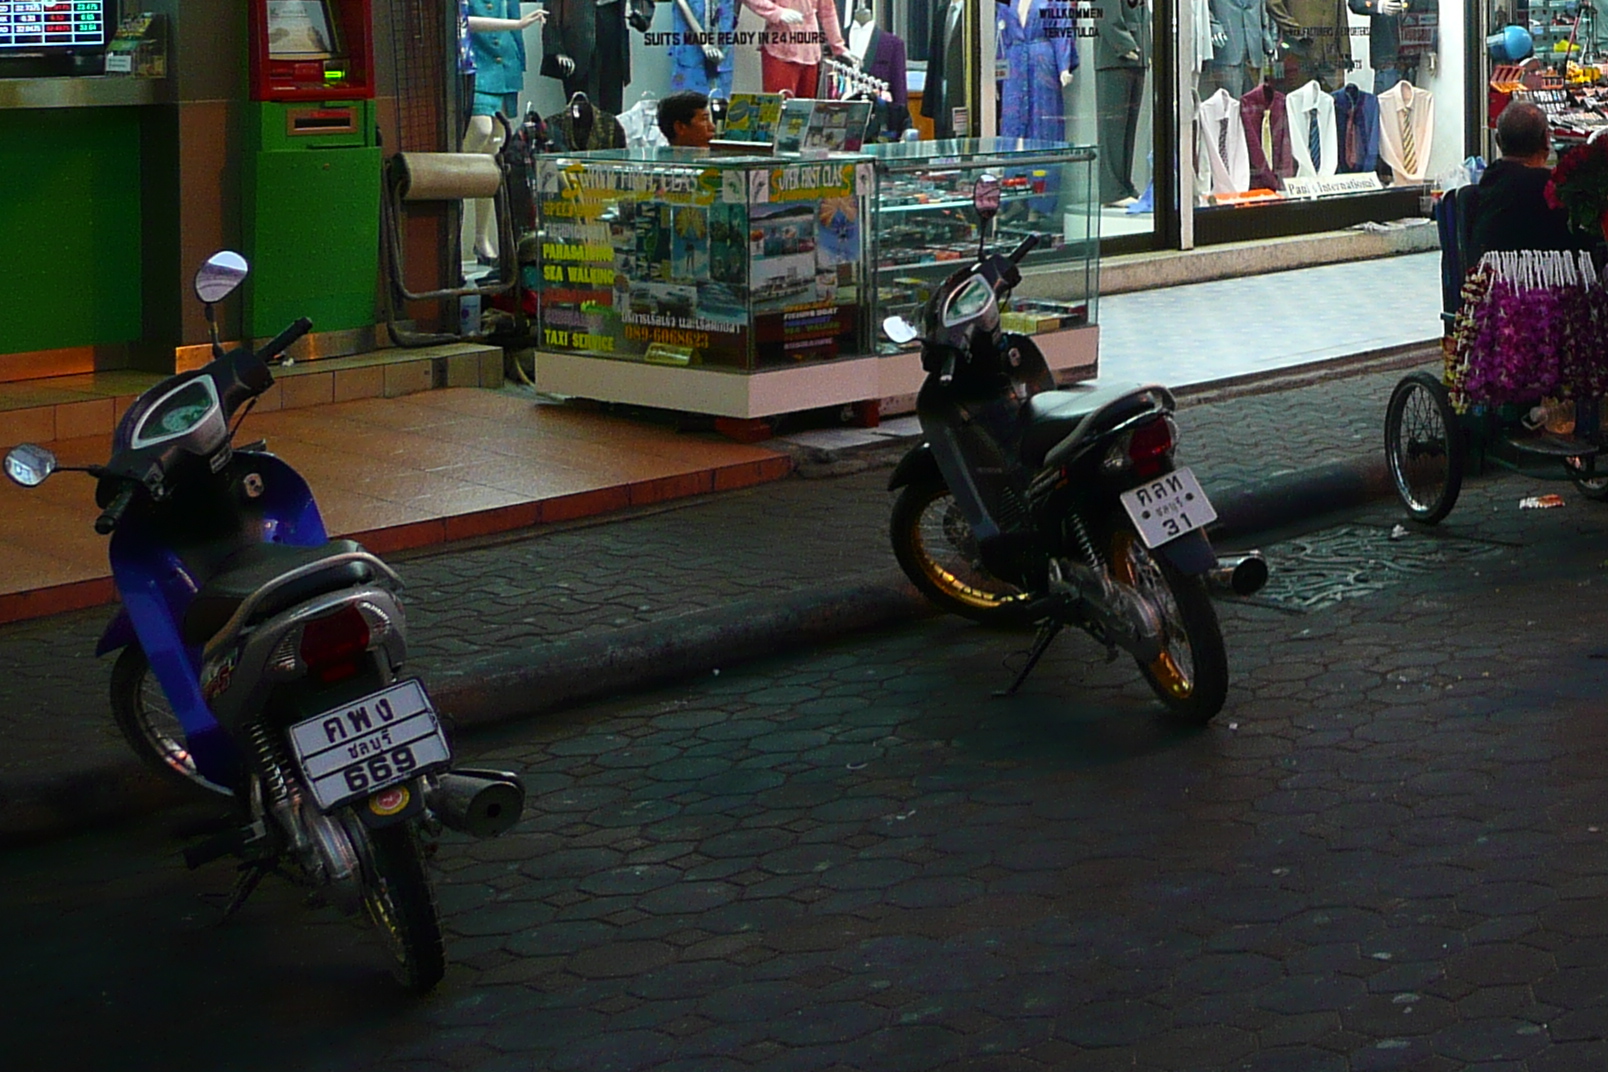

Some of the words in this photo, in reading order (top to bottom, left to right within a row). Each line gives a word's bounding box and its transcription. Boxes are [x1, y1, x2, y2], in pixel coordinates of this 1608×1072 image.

[1040, 8, 1103, 19] WILLKOMMEN
[644, 33, 680, 46] SUITS
[684, 32, 714, 45] MADE
[717, 32, 756, 45] READY
[758, 32, 770, 44] IN
[772, 32, 787, 44] 24
[789, 31, 826, 44] HOURS
[770, 168, 799, 202] SUPER
[823, 164, 854, 196] CLASS
[1317, 173, 1379, 195] International
[543, 265, 564, 282] SEA
[569, 267, 614, 284] WALKING
[544, 329, 568, 345] TAXI
[572, 332, 614, 351] SERVICE
[1162, 513, 1192, 536] 31
[347, 729, 392, 759] ชลบุรี
[343, 746, 417, 792] 669
